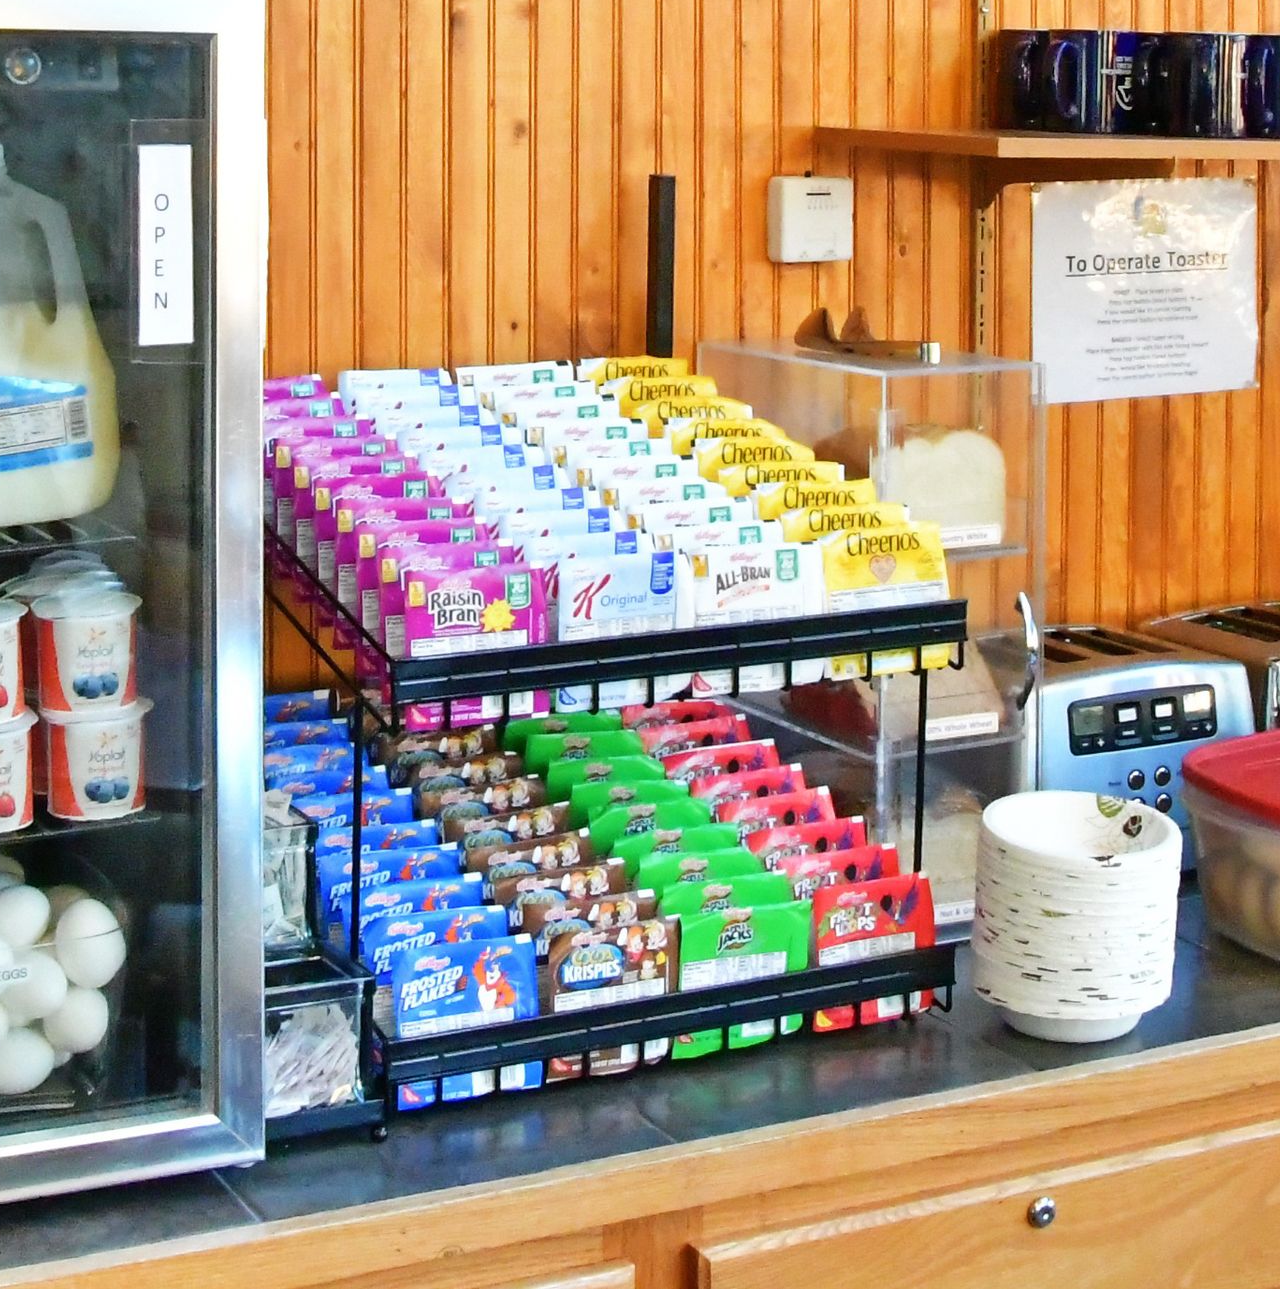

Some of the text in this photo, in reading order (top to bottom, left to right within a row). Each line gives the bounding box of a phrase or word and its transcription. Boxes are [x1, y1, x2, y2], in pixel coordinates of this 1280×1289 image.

[154, 193, 169, 309] OPEN
[1065, 250, 1229, 274] To Operate Toaster
[629, 380, 696, 402] Cheerios
[721, 441, 793, 464] Cheerios
[783, 486, 856, 510] Cheerios
[808, 508, 882, 533] Cheerios
[846, 531, 921, 557] Cheerios
[715, 565, 771, 595] ALL-BRAN
[430, 589, 482, 611] Raisin
[573, 573, 648, 620] K Original
[437, 608, 477, 626] Bran
[717, 929, 753, 954] JACKS
[401, 965, 464, 999] FROSTED
[563, 960, 622, 984] KRISPIES
[403, 980, 457, 1012] FLAKES
